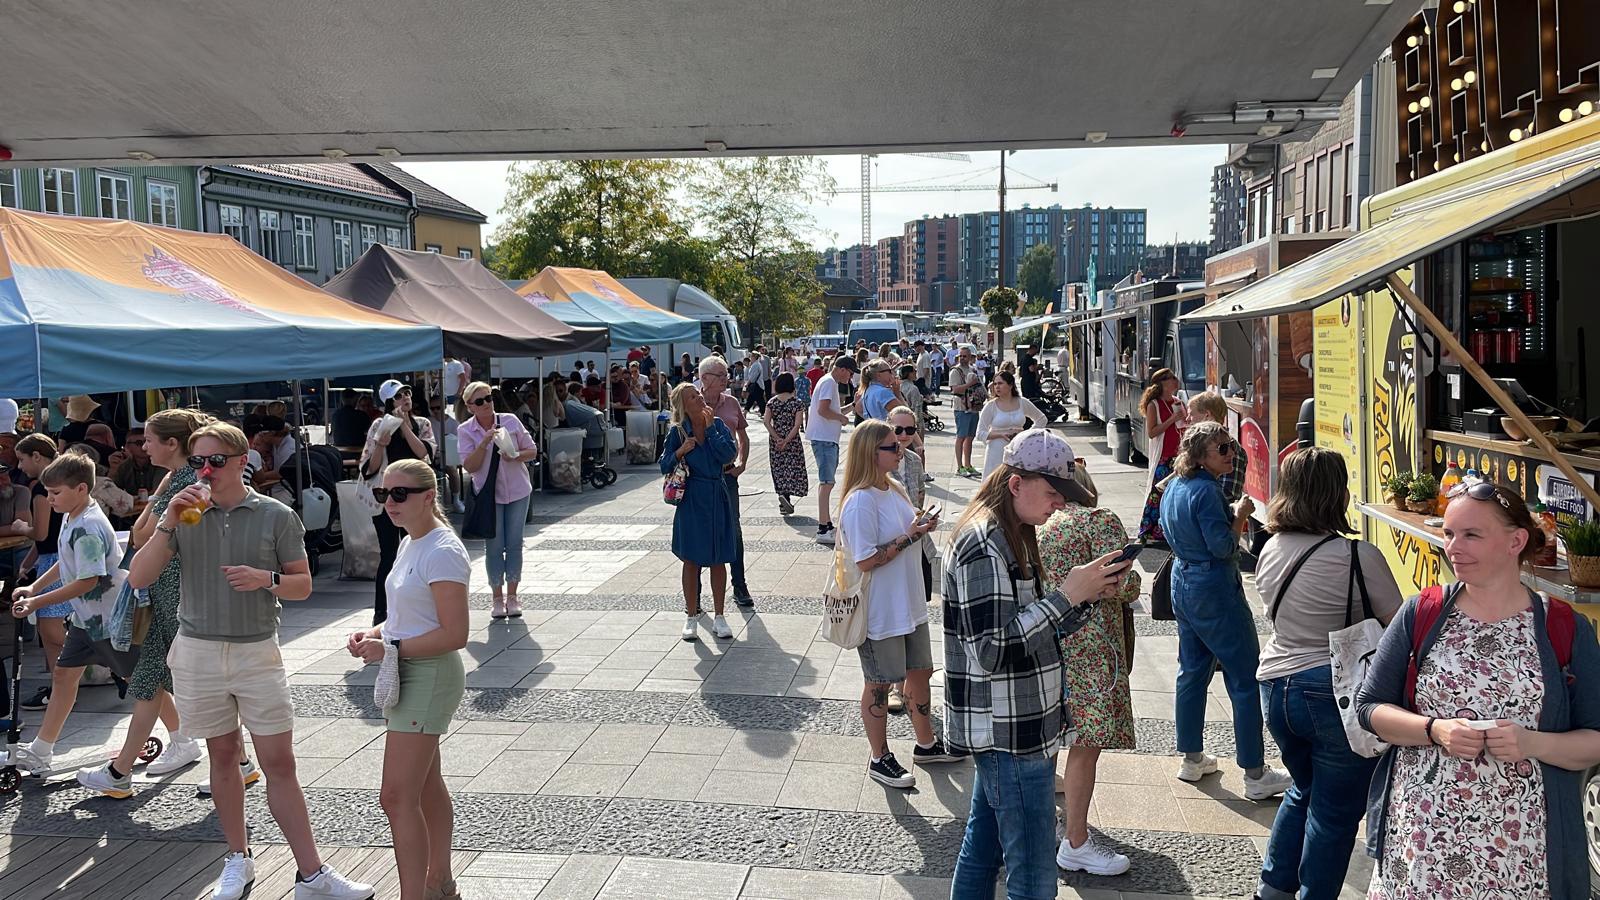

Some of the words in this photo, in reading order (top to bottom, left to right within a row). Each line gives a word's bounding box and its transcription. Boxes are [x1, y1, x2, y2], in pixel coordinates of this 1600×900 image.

[1388, 361, 1396, 371] TM
[1549, 497, 1569, 510] STREET
[1570, 502, 1585, 514] FOOD
